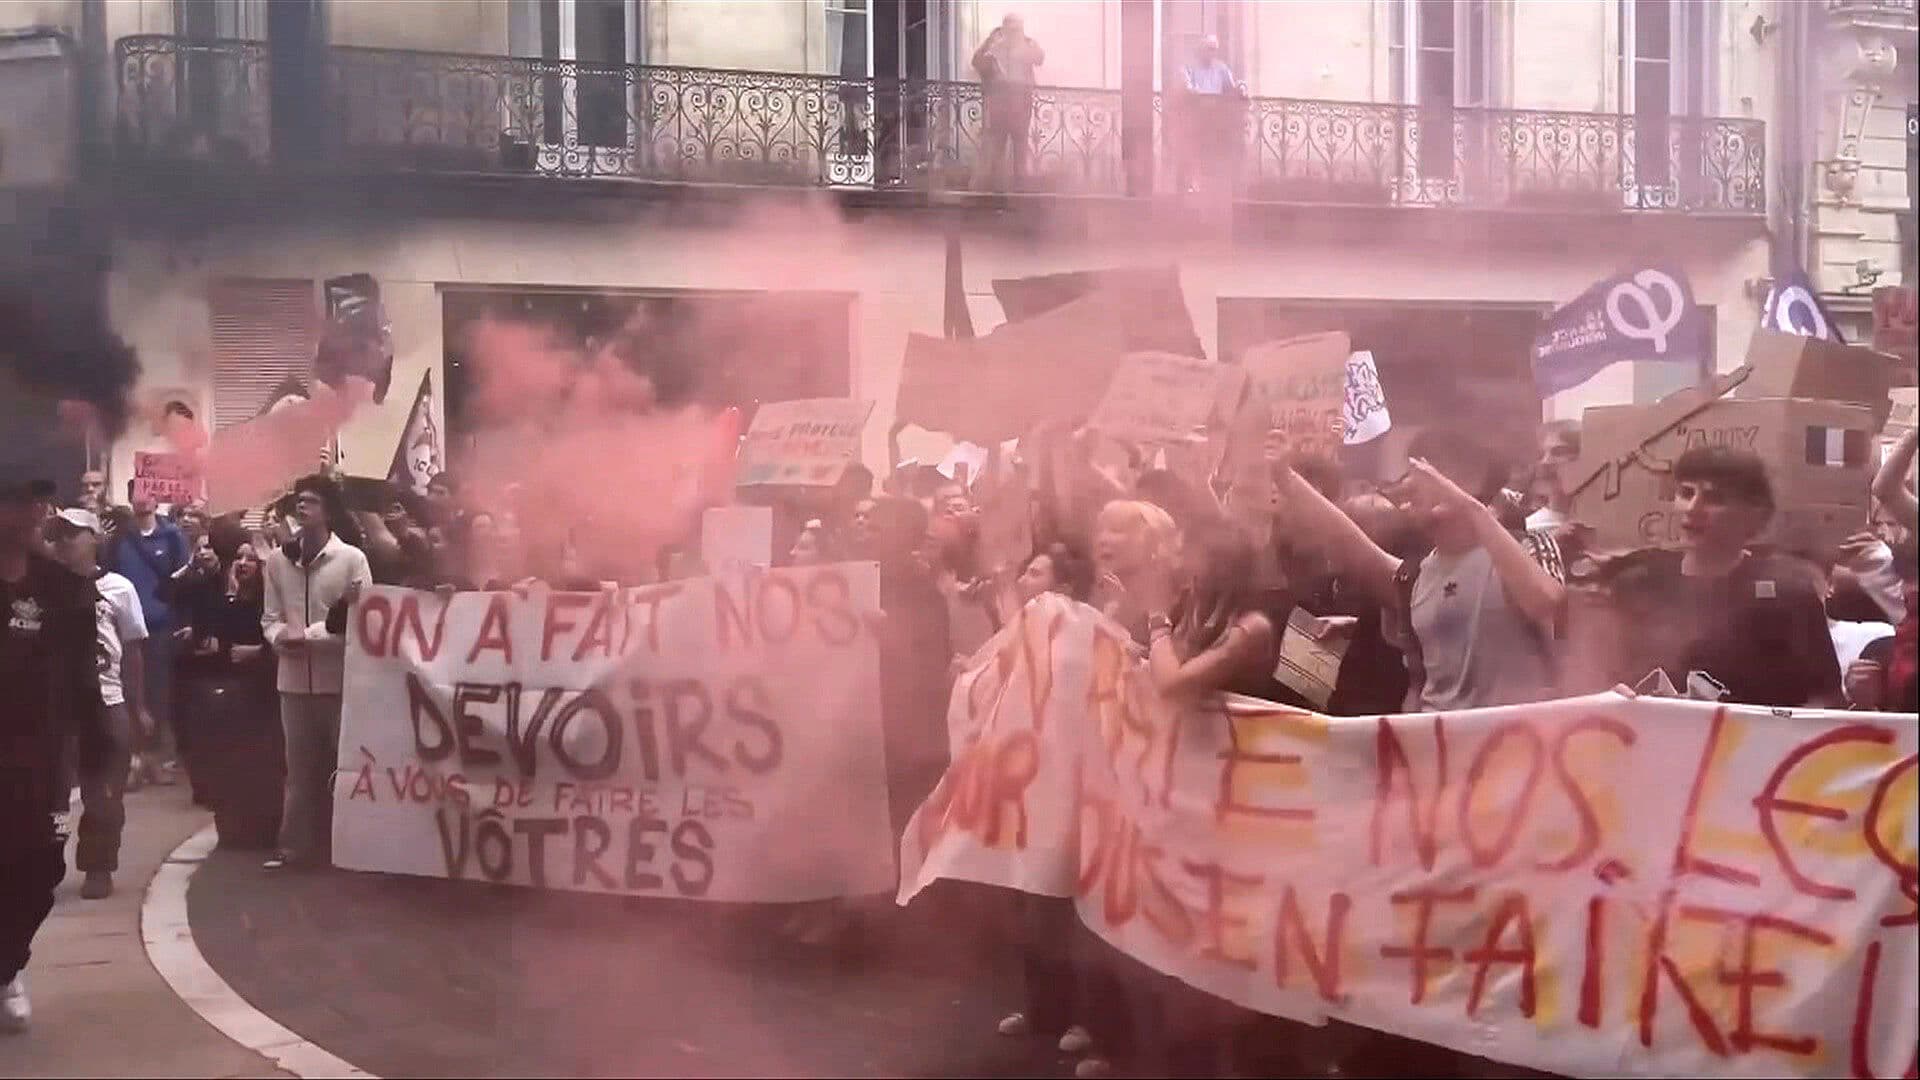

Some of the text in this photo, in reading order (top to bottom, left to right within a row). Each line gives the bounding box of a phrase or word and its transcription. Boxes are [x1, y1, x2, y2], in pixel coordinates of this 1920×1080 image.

[358, 572, 859, 665] ON A FAIT NOS
[350, 746, 755, 819] À VOUS DE FAIRE LES
[1370, 715, 1635, 872] NOS
[436, 806, 715, 896] VÔTRES
[1184, 858, 1352, 1002] EN
